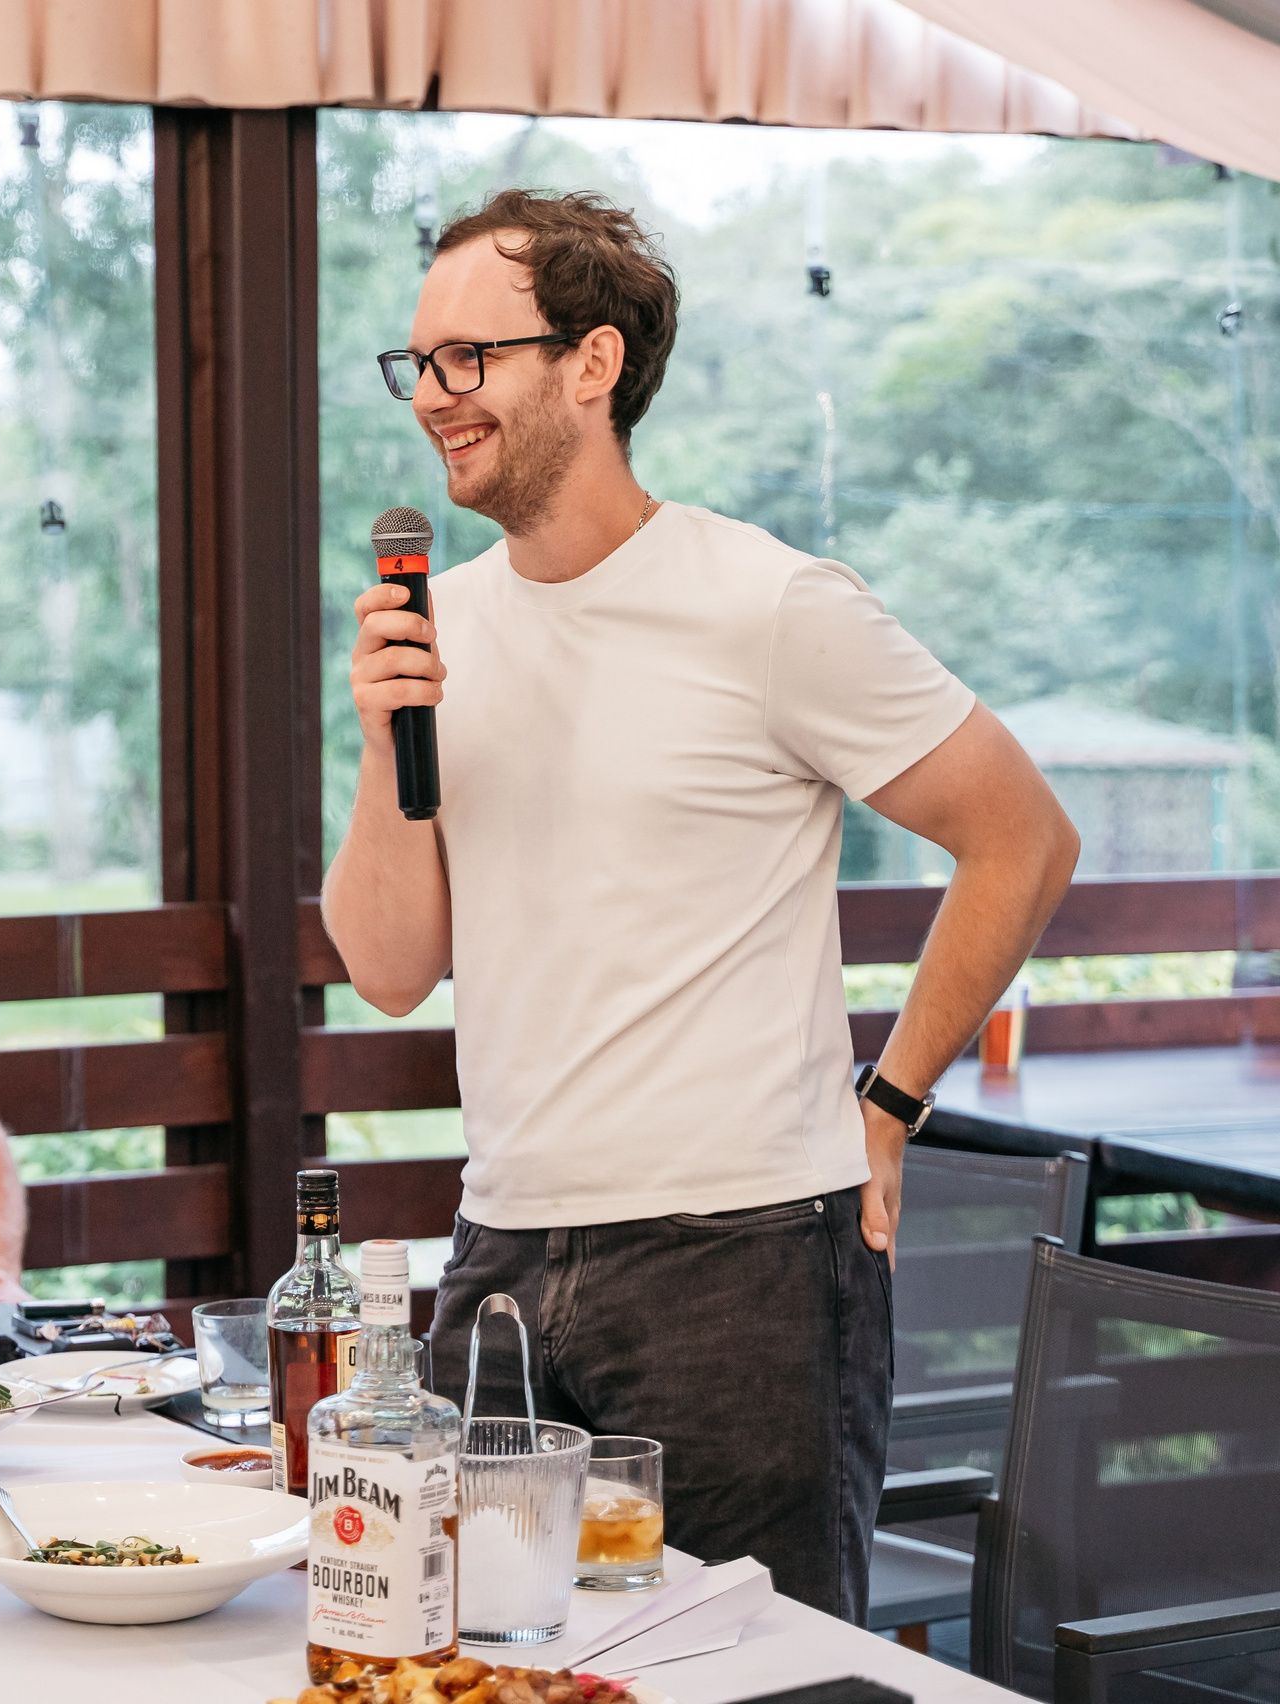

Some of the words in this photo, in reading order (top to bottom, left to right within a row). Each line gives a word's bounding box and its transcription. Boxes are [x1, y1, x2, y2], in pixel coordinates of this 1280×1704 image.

[394, 558, 404, 572] 4
[382, 1293, 403, 1306] BEAM
[310, 1471, 340, 1510] JIM
[342, 1466, 401, 1524] BEAM
[320, 1555, 348, 1568] KENTUCKY
[349, 1560, 378, 1573] STRAIGHT
[312, 1563, 389, 1600] BOURBON
[331, 1592, 364, 1609] WHISKEY
